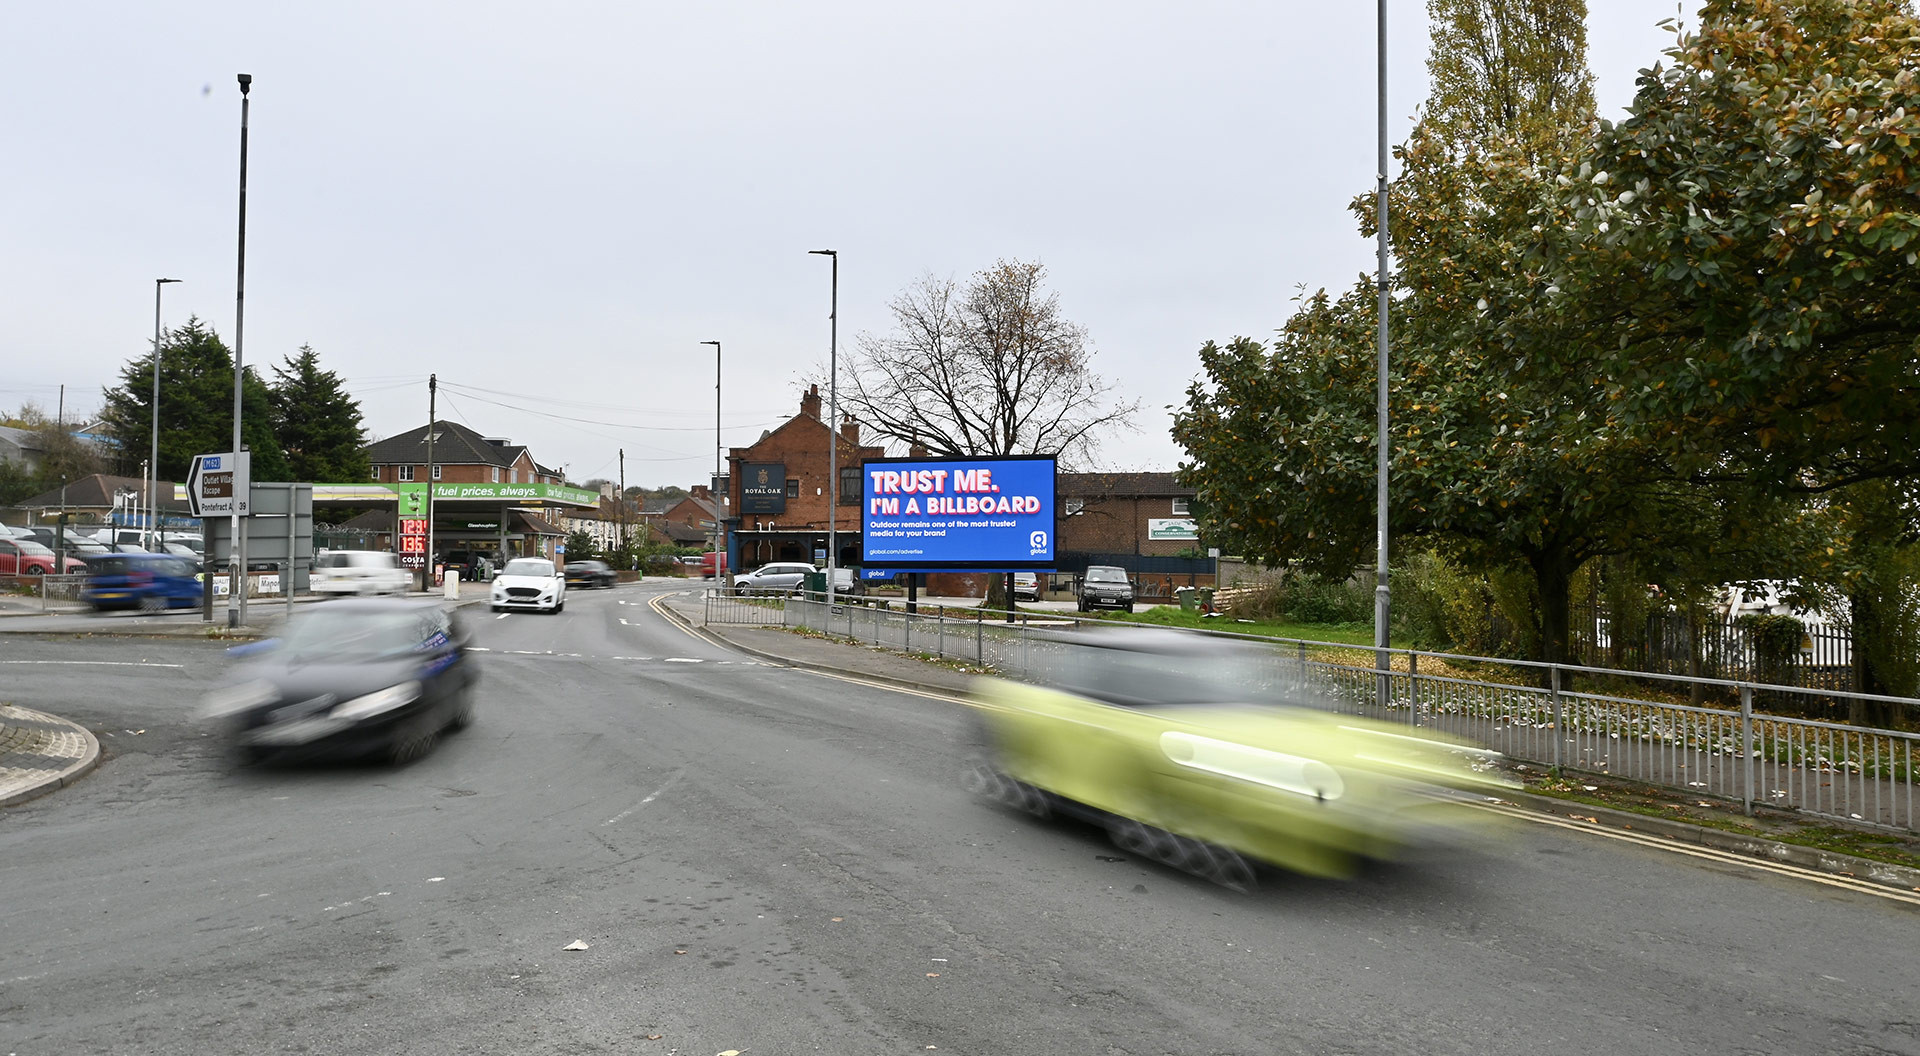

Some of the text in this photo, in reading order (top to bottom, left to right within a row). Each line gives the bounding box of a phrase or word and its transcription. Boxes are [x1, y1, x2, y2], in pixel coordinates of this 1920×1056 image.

[203, 475, 234, 485] Outlet Villag
[870, 469, 1000, 494] TRUST ME.
[203, 487, 221, 496] Xscape
[437, 487, 458, 496] fuel
[461, 487, 496, 498] prices,
[499, 486, 538, 498] always.
[202, 502, 247, 511] Pontefract A39
[870, 495, 1041, 516] I'M A BILLBOARD
[870, 521, 900, 529] Outdoor
[956, 520, 969, 528] the
[970, 520, 988, 528] most
[990, 520, 1016, 528] trusted
[895, 529, 905, 537] for
[906, 530, 922, 538] your
[868, 570, 885, 578] global
